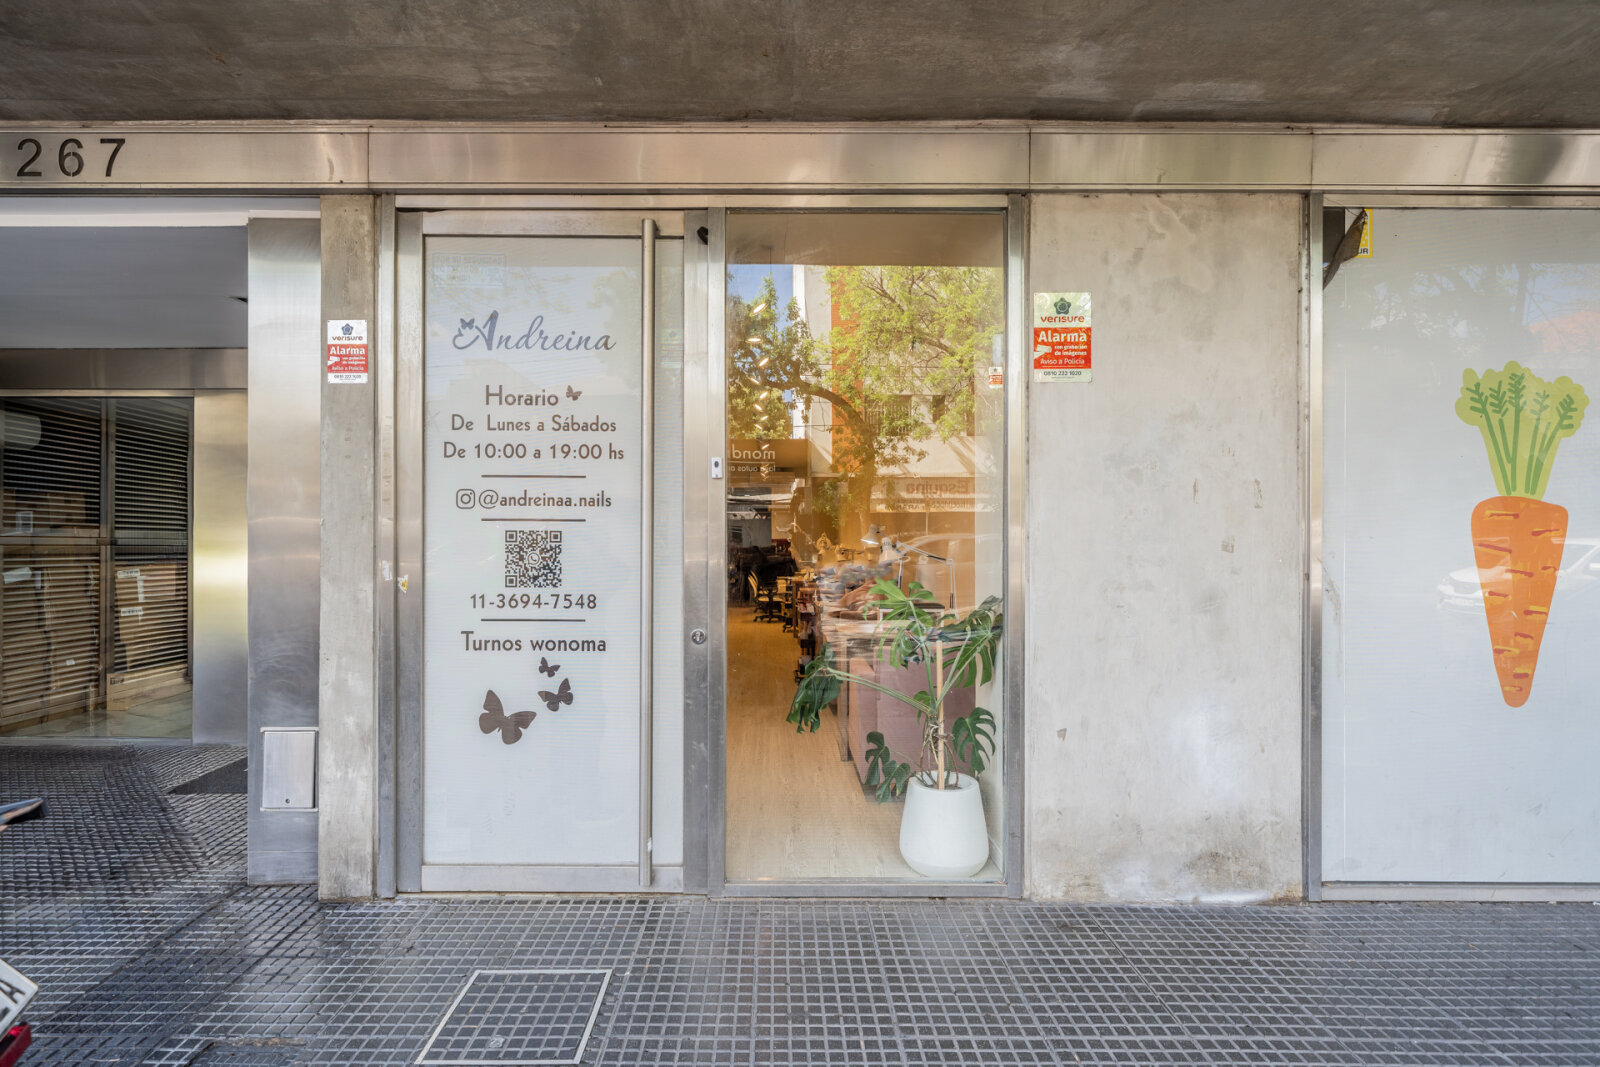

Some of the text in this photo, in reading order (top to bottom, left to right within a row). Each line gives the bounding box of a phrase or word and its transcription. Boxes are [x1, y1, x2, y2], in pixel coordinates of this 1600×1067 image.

[16, 137, 126, 178] 267
[1040, 315, 1085, 323] verisure
[452, 309, 617, 351] Andreina
[1038, 330, 1087, 342] Alarma
[330, 345, 365, 355] Alarma
[486, 385, 559, 407] Horario
[451, 414, 617, 432] De Lunes a Sábados
[443, 442, 625, 460] De 10:00 a 19:00 hs
[478, 489, 612, 509] @andreinaa.nails
[470, 593, 597, 610] 11-3694-7548
[460, 630, 607, 652] Turnos wonoma
